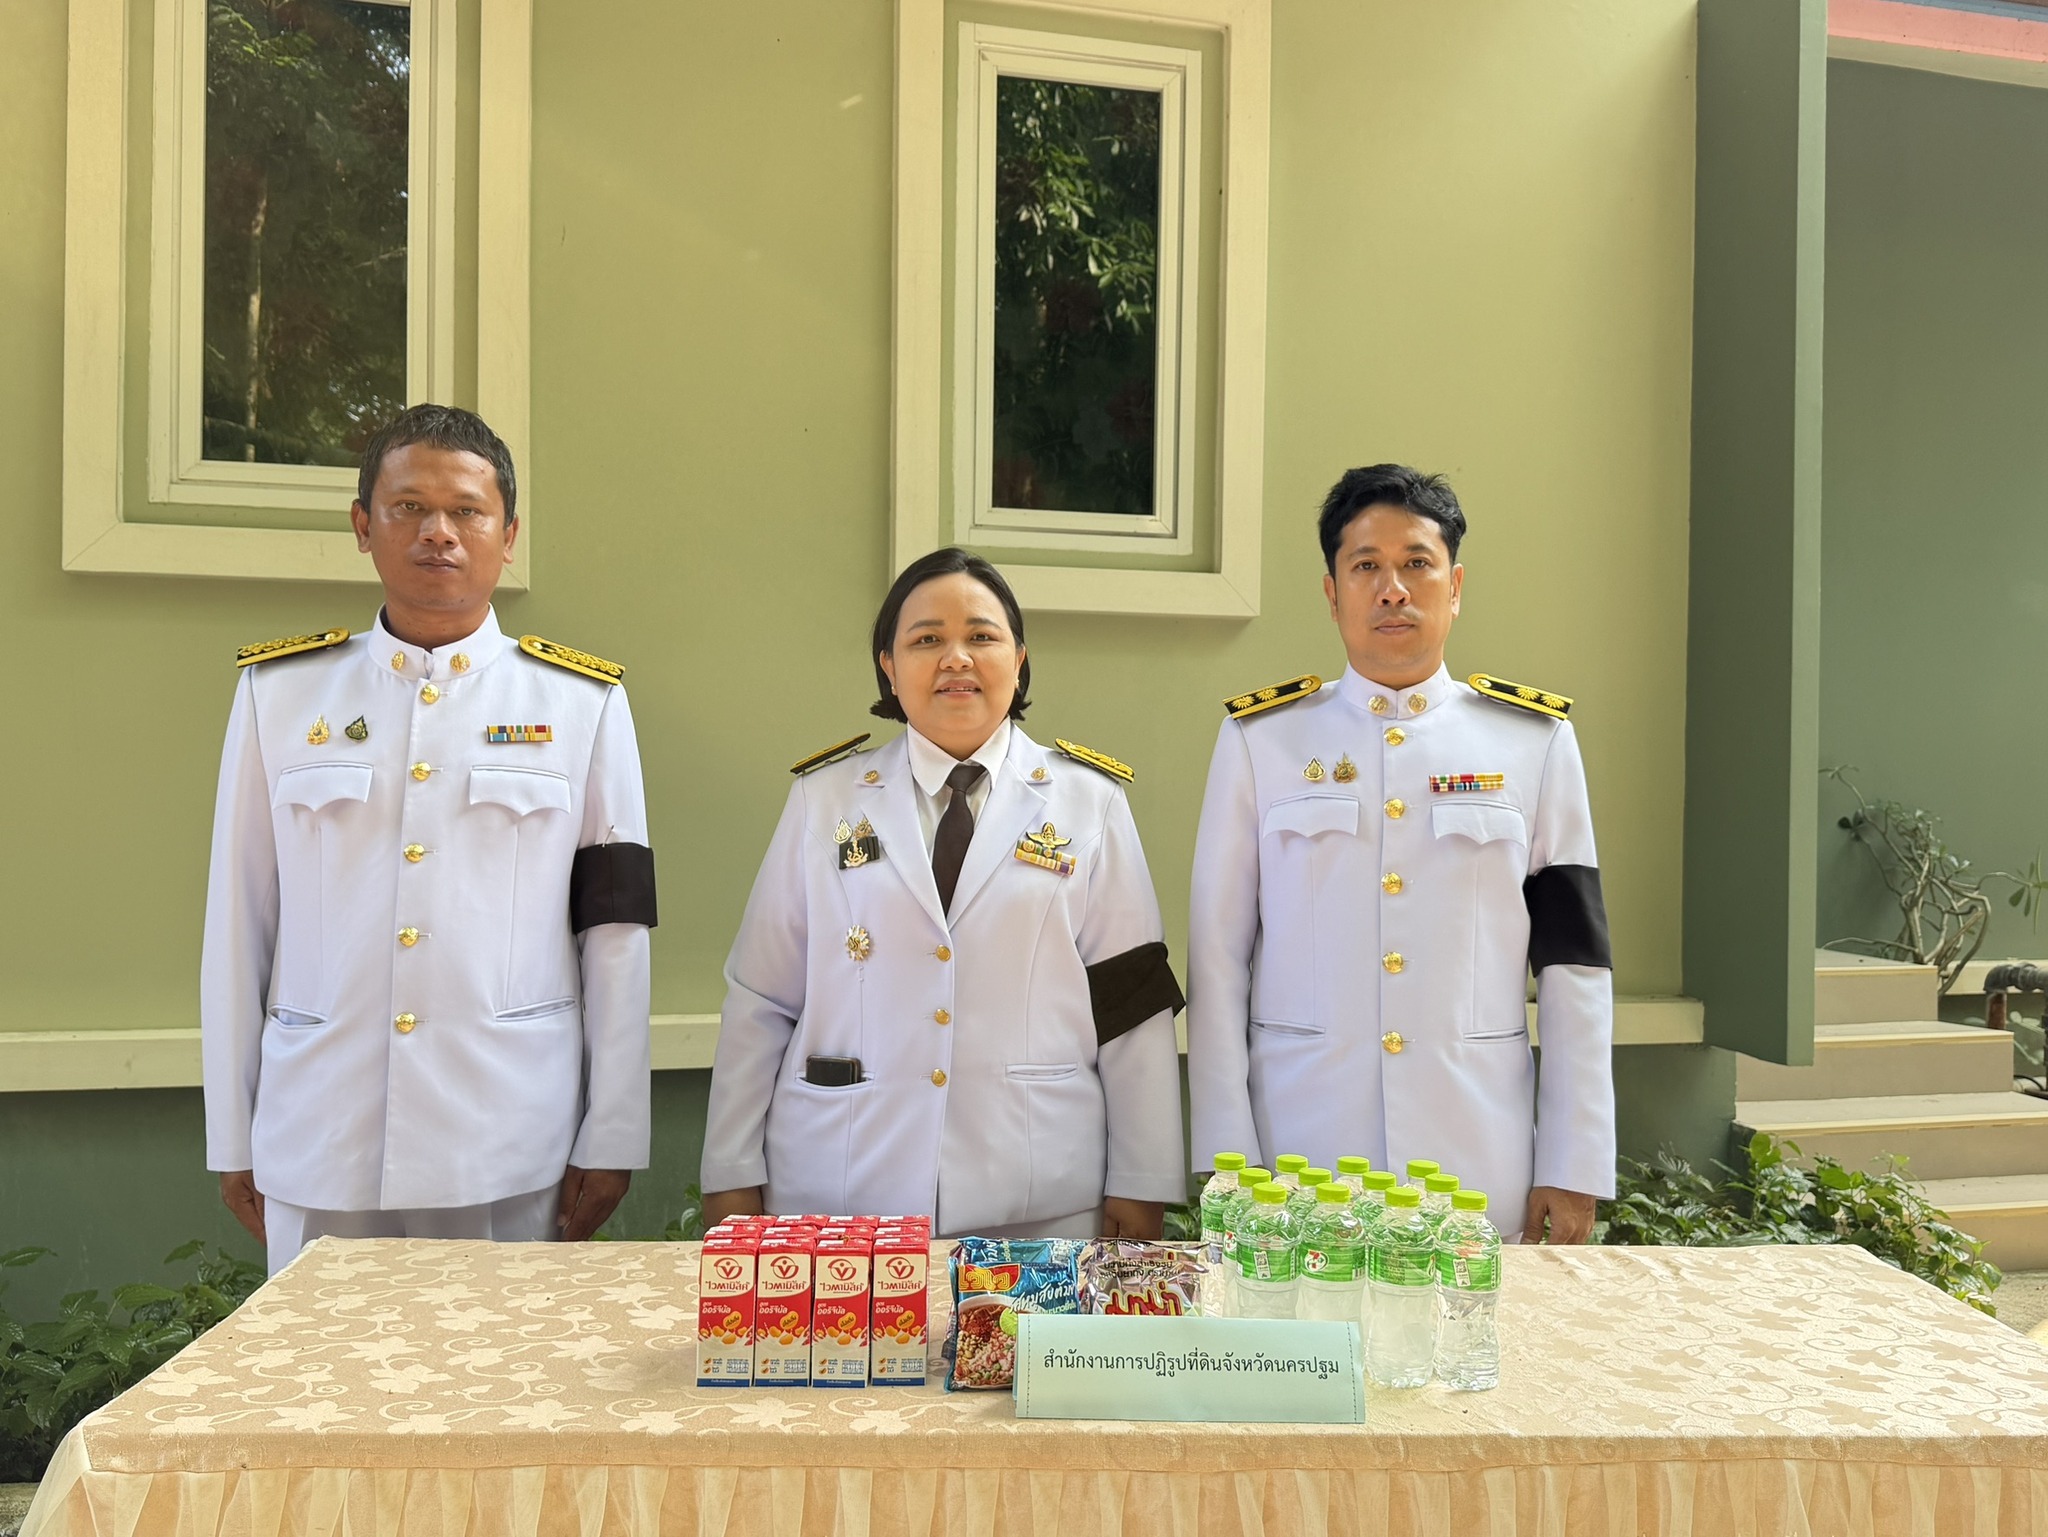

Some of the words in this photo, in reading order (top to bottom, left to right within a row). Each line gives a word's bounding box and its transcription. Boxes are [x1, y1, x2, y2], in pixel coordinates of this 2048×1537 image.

[1043, 1347, 1339, 1380] สำนักงานการปฏิรูปที่ดินจังหวัดนครปฐม
